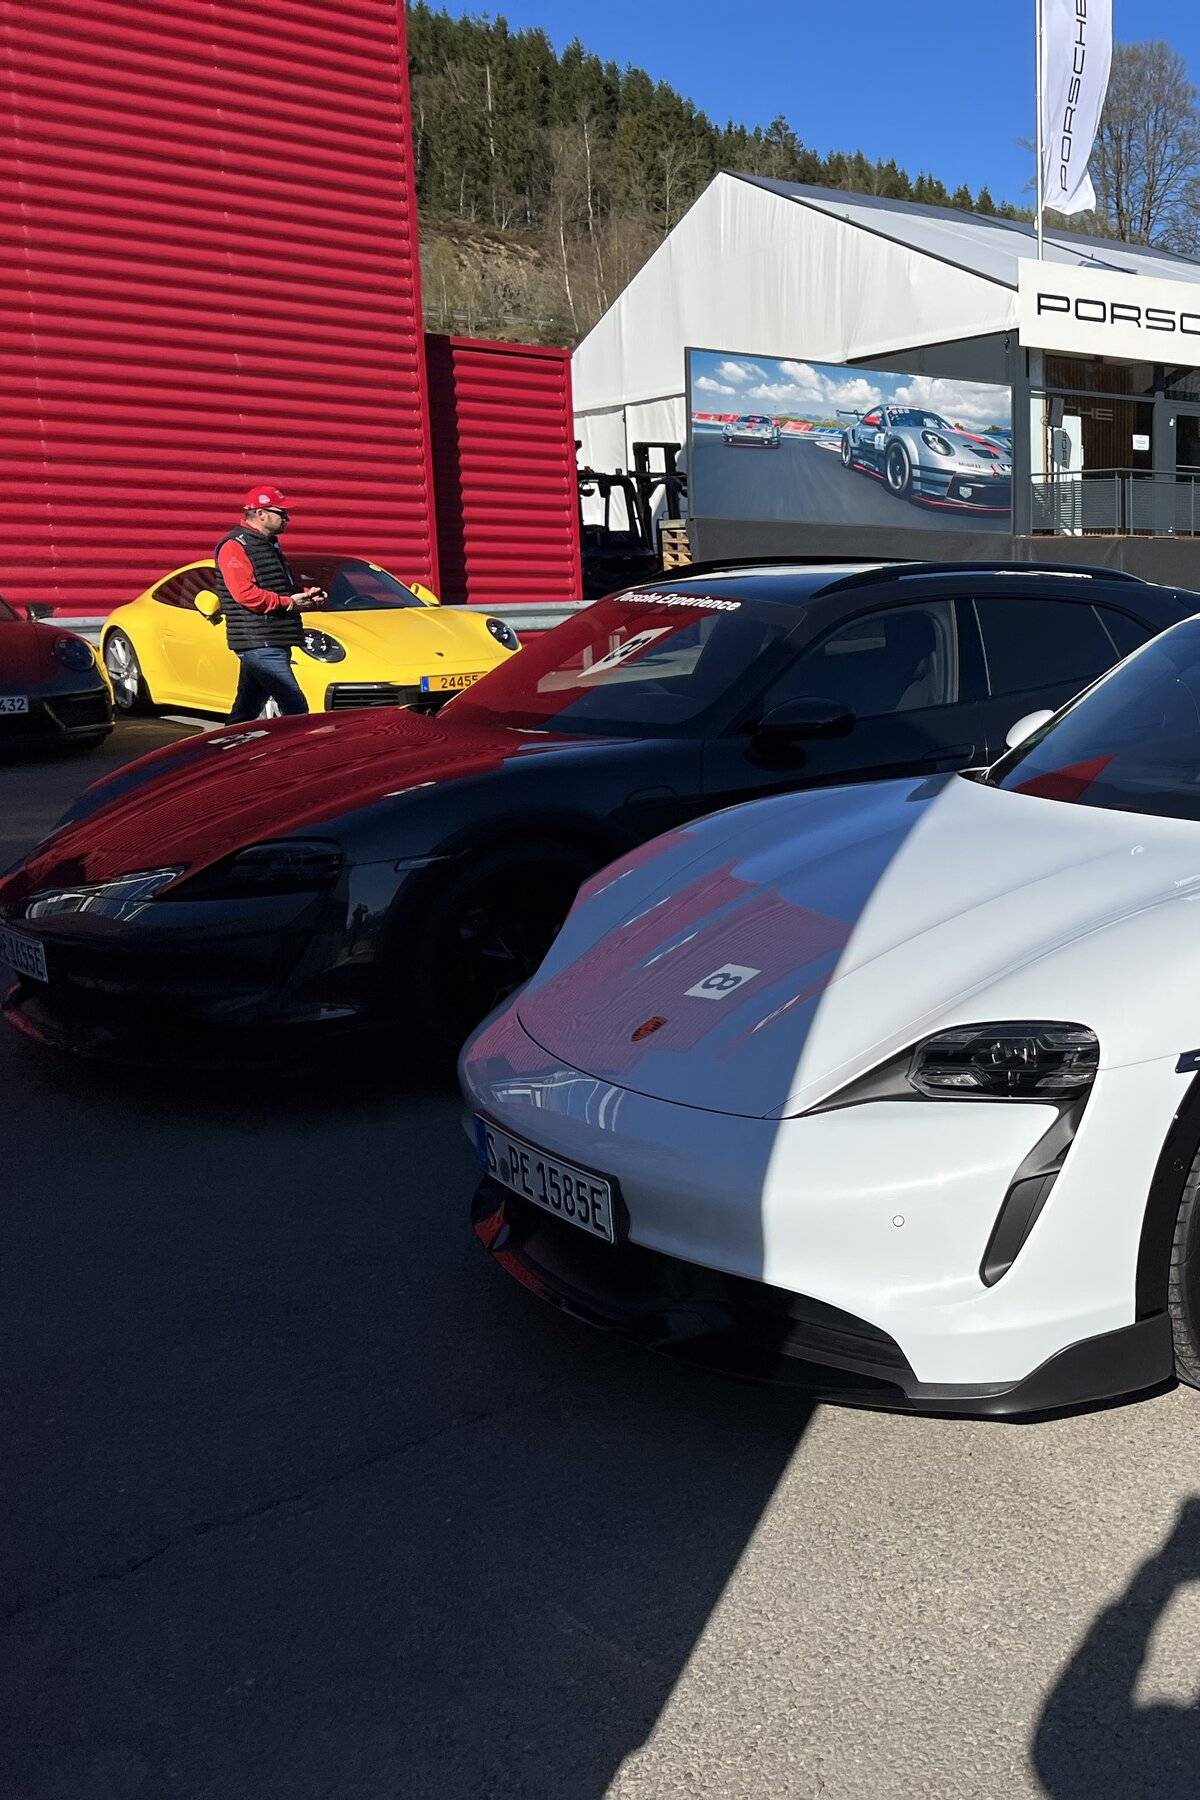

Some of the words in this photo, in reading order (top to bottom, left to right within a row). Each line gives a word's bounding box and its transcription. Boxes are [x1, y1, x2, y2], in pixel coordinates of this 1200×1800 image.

[1060, 0, 1087, 191] PORSCHE
[614, 591, 661, 604] Porsche
[656, 593, 742, 611] Experience
[486, 1131, 497, 1173] S
[508, 1144, 534, 1197] PE
[536, 1162, 606, 1234] 1585E
